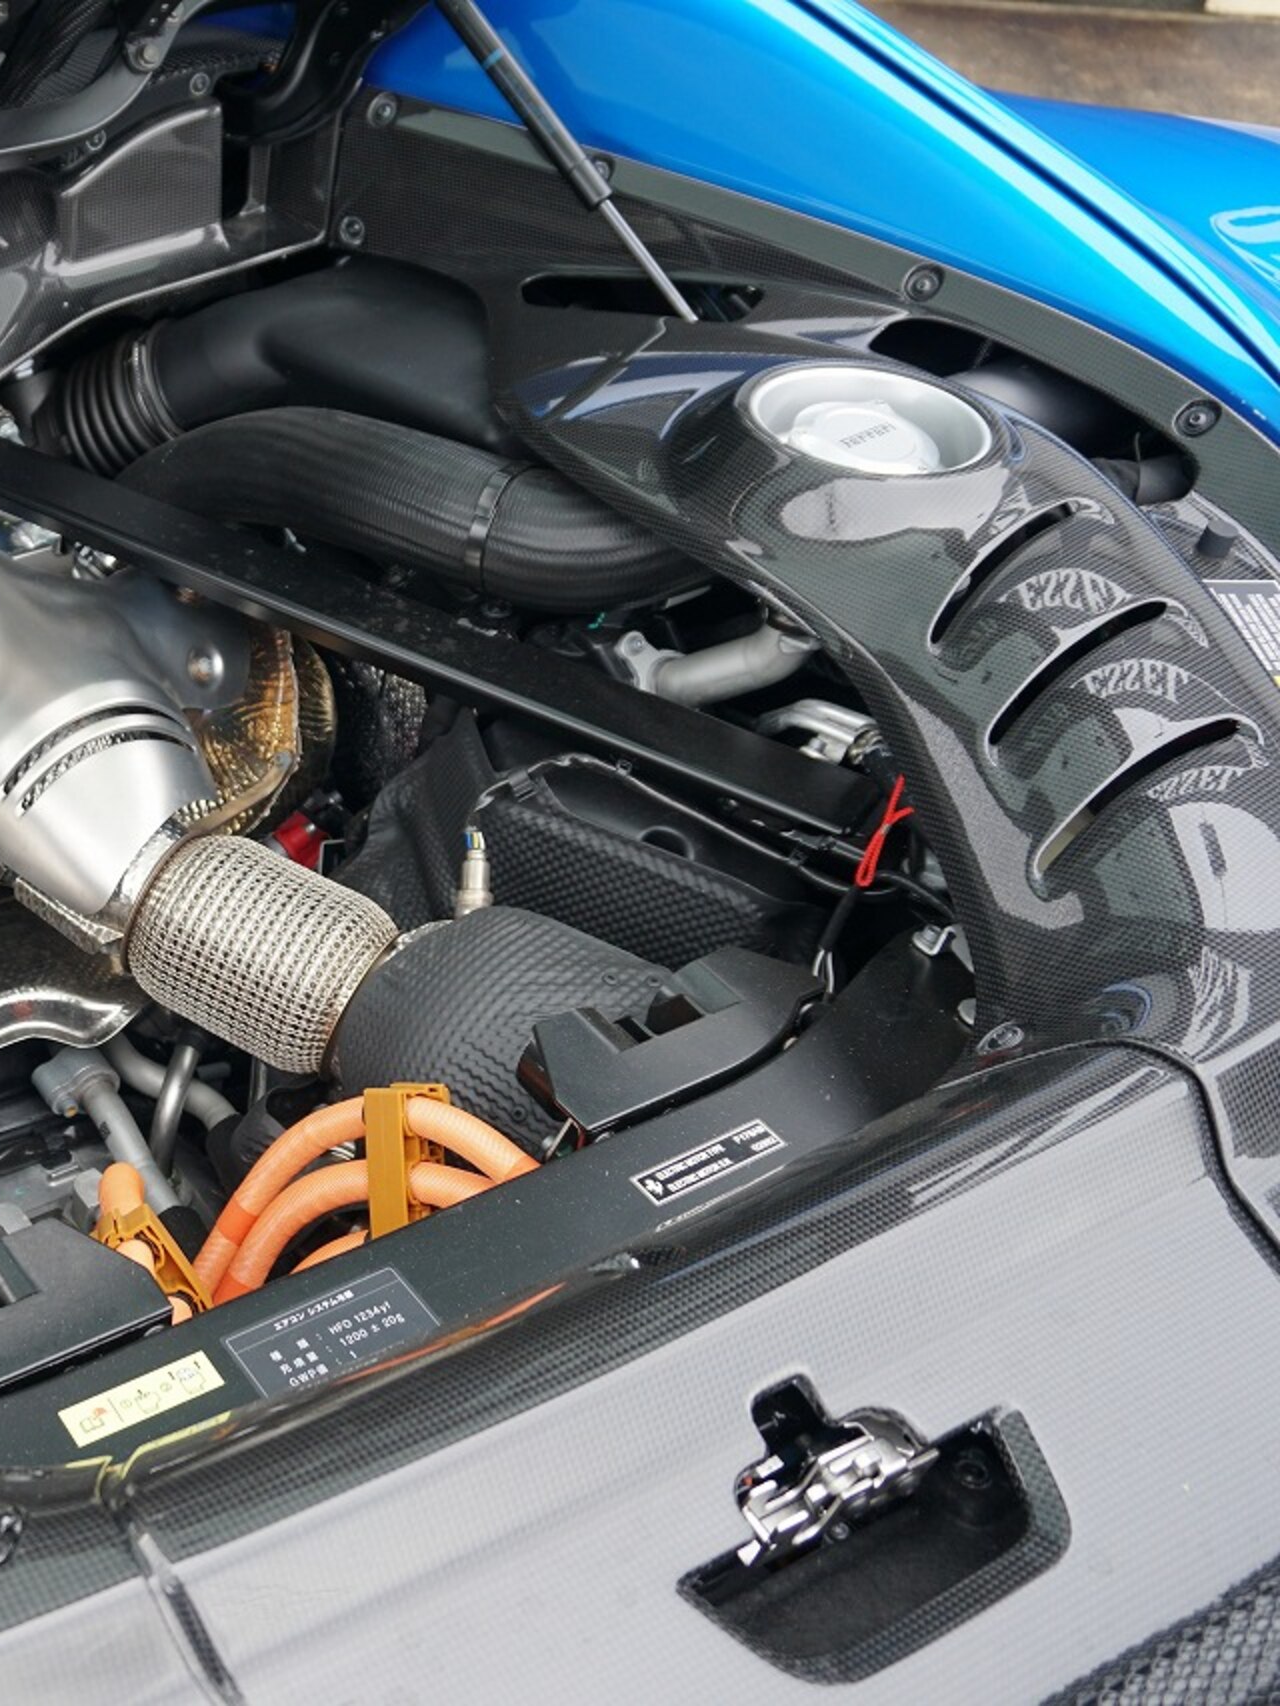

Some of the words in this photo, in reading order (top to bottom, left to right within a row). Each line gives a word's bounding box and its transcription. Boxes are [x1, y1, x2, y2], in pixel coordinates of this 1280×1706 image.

[839, 423, 897, 449] Ferrari
[328, 1318, 353, 1336] HFO
[353, 1301, 391, 1323] 1234yf
[339, 1328, 369, 1347] 1200
